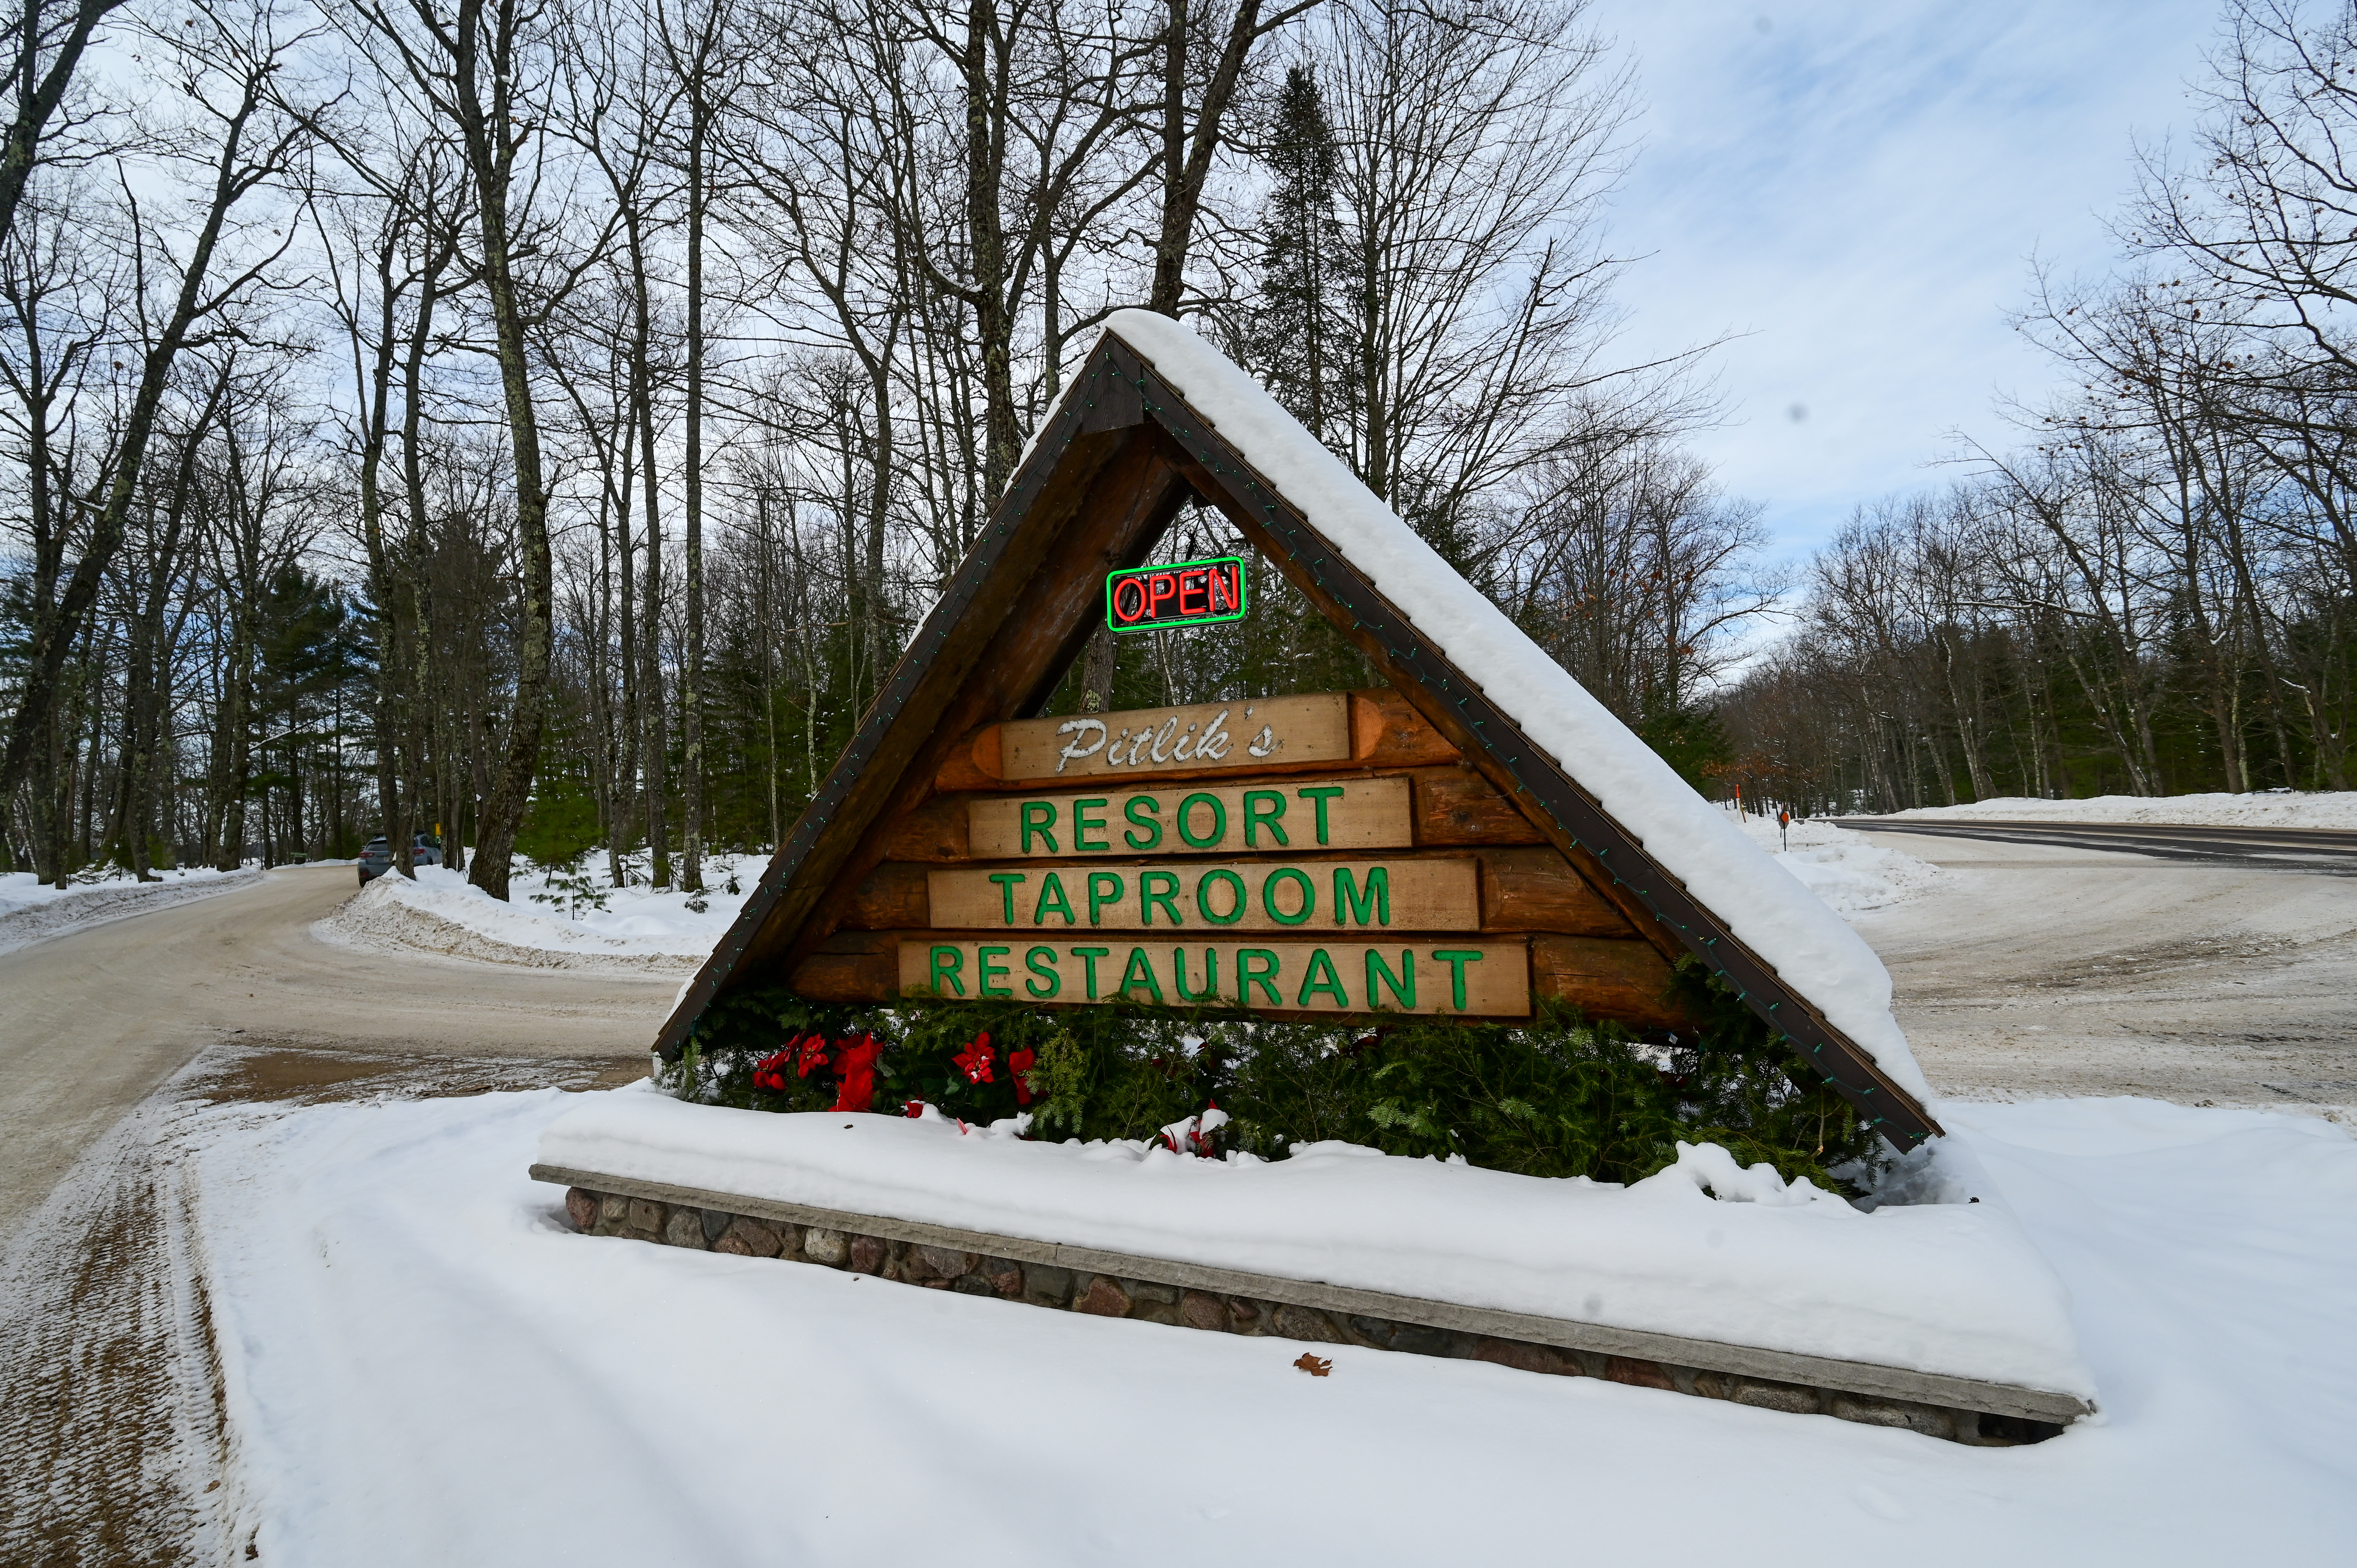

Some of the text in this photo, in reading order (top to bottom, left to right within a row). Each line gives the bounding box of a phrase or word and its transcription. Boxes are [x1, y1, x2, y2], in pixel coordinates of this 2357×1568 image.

[1113, 566, 1239, 622] OPEN
[1056, 706, 1282, 773] Pitlik's
[1020, 786, 1345, 854] RESORT
[989, 866, 1391, 926] TAPROOM
[929, 945, 1484, 1012] RESTAURANT
